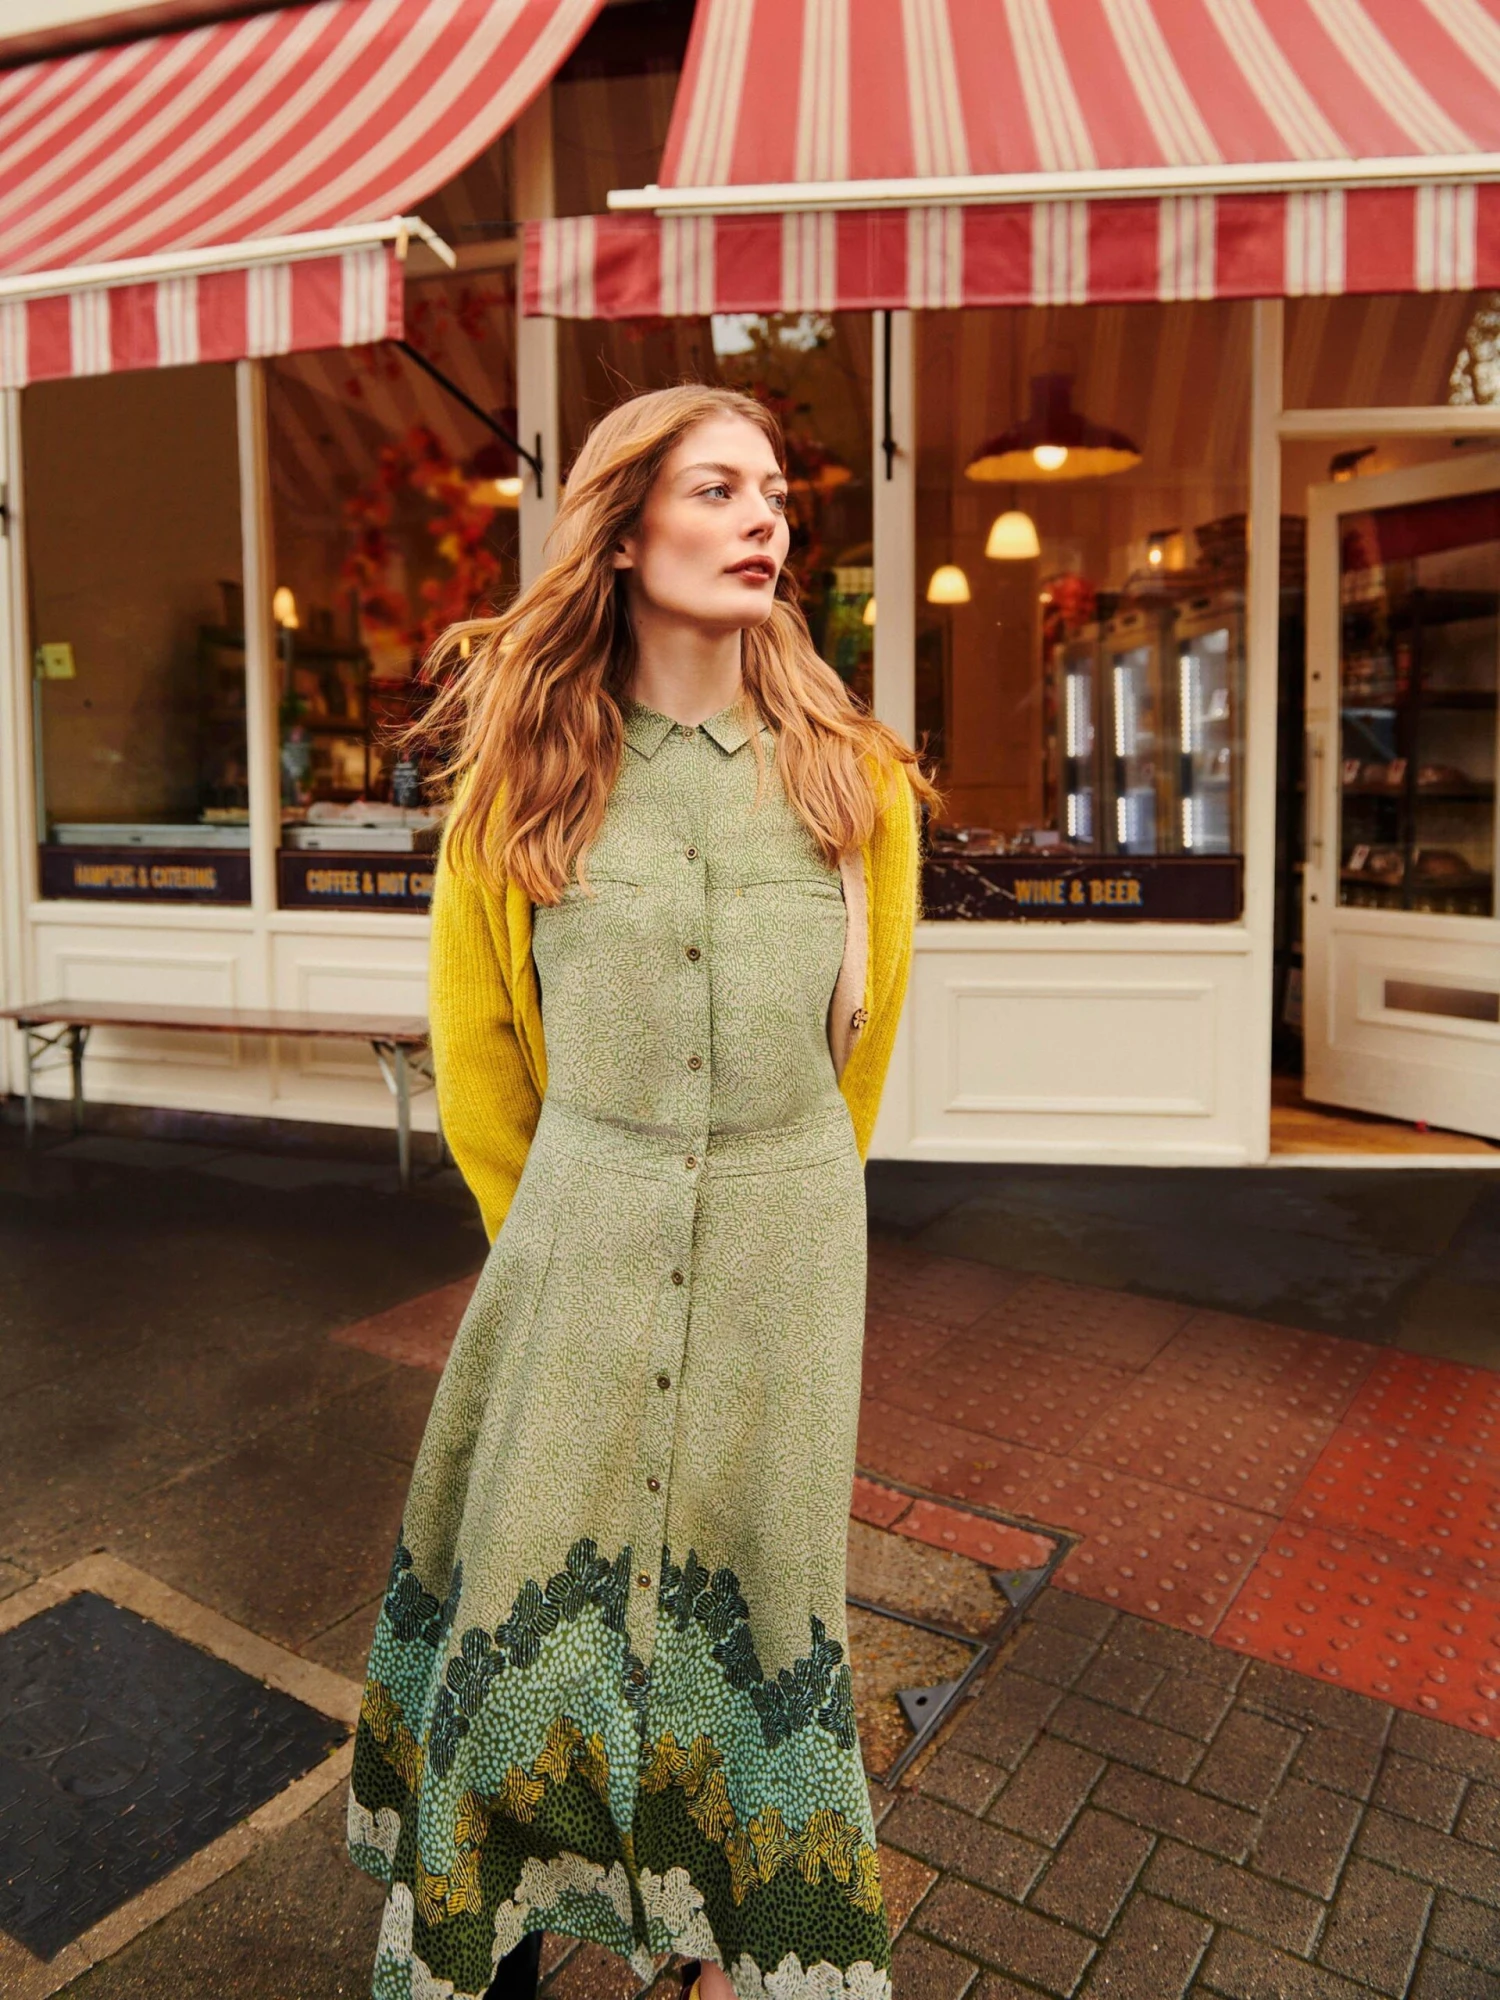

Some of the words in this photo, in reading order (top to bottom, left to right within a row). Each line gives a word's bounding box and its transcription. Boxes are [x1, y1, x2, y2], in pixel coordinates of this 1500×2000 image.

[151, 866, 217, 889] CATERING
[306, 869, 360, 894] COFFEE
[361, 871, 374, 894] &
[377, 871, 407, 897] HOT
[1014, 879, 1065, 905] WINE
[1069, 879, 1085, 905] &
[1090, 879, 1143, 906] BEER
